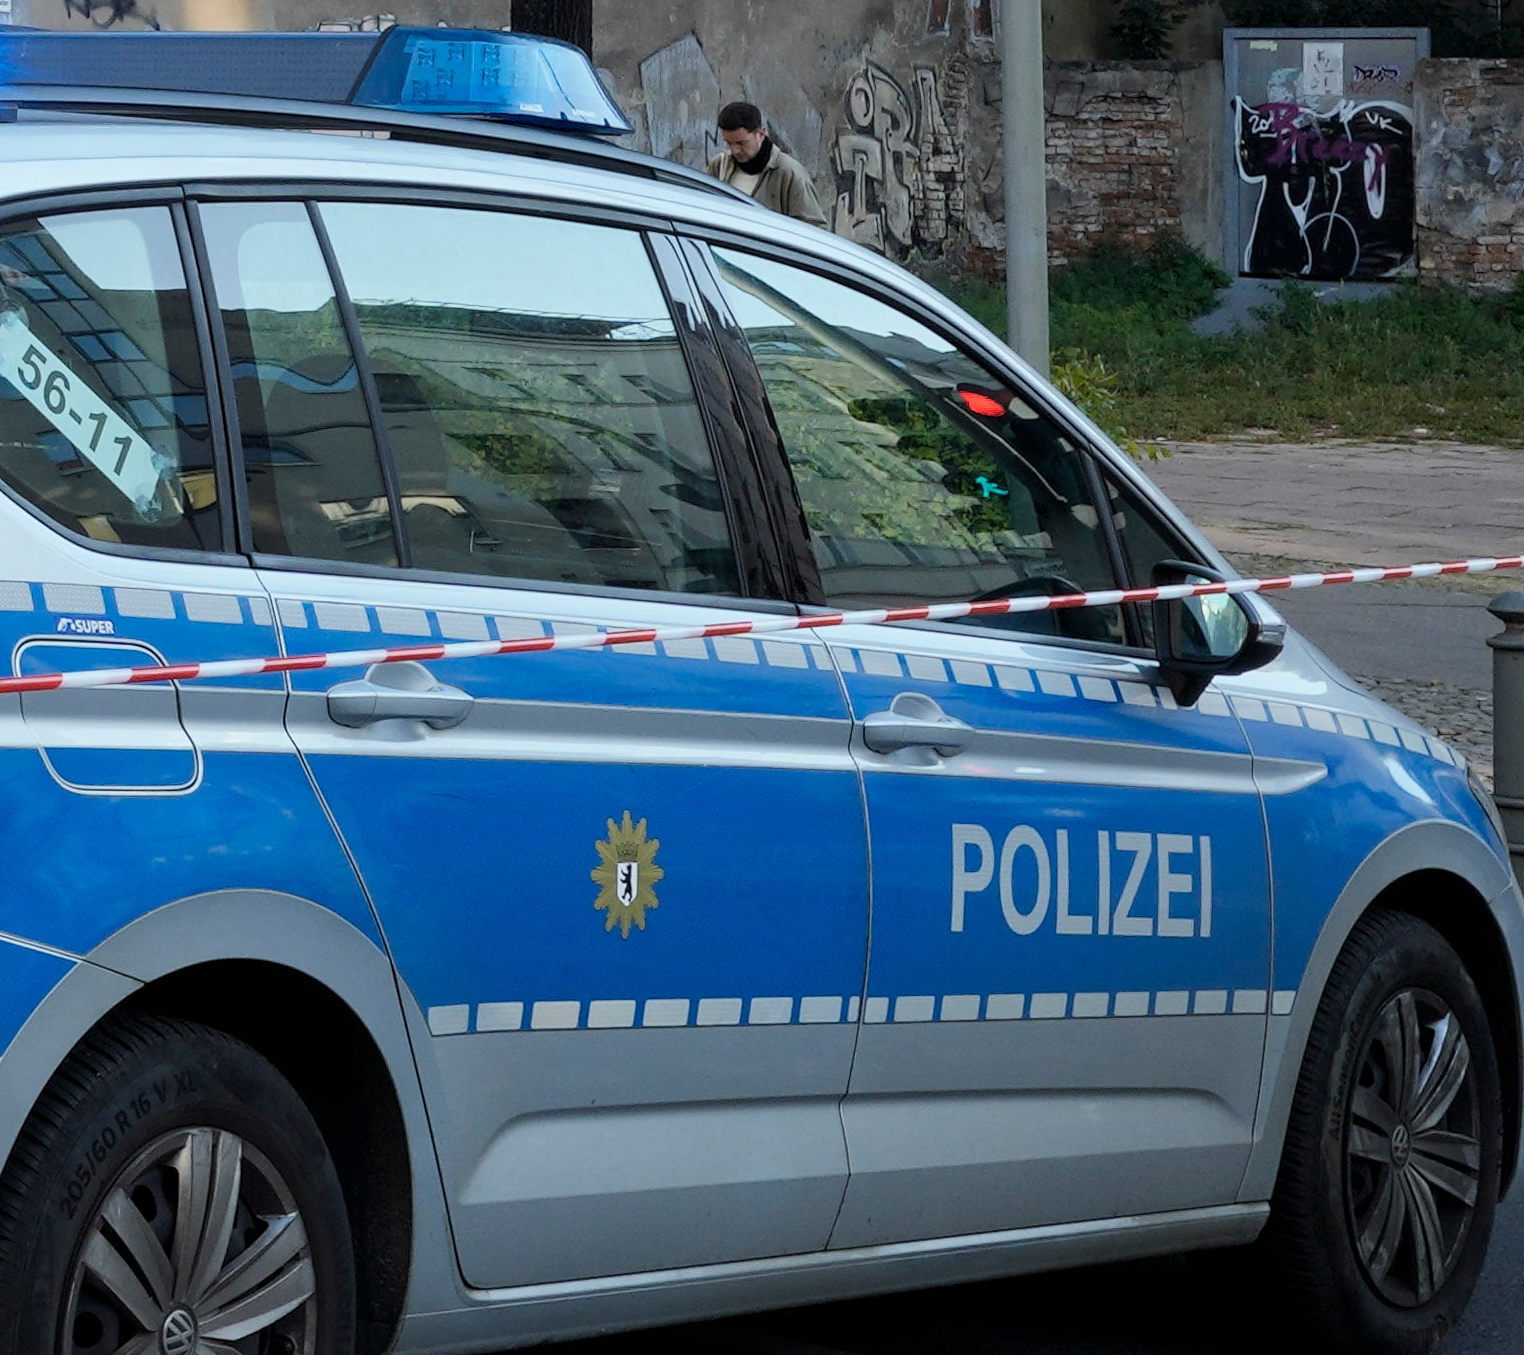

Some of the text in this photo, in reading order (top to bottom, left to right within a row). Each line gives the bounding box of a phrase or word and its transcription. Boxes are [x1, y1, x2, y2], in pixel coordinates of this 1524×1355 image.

[16, 342, 137, 480] 56-11
[75, 619, 115, 634] SUPER
[949, 822, 1214, 939] POLIZEI
[60, 1122, 117, 1220] 205/60
[114, 1111, 133, 1131] R
[134, 1094, 151, 1120] 16
[154, 1081, 169, 1105] V
